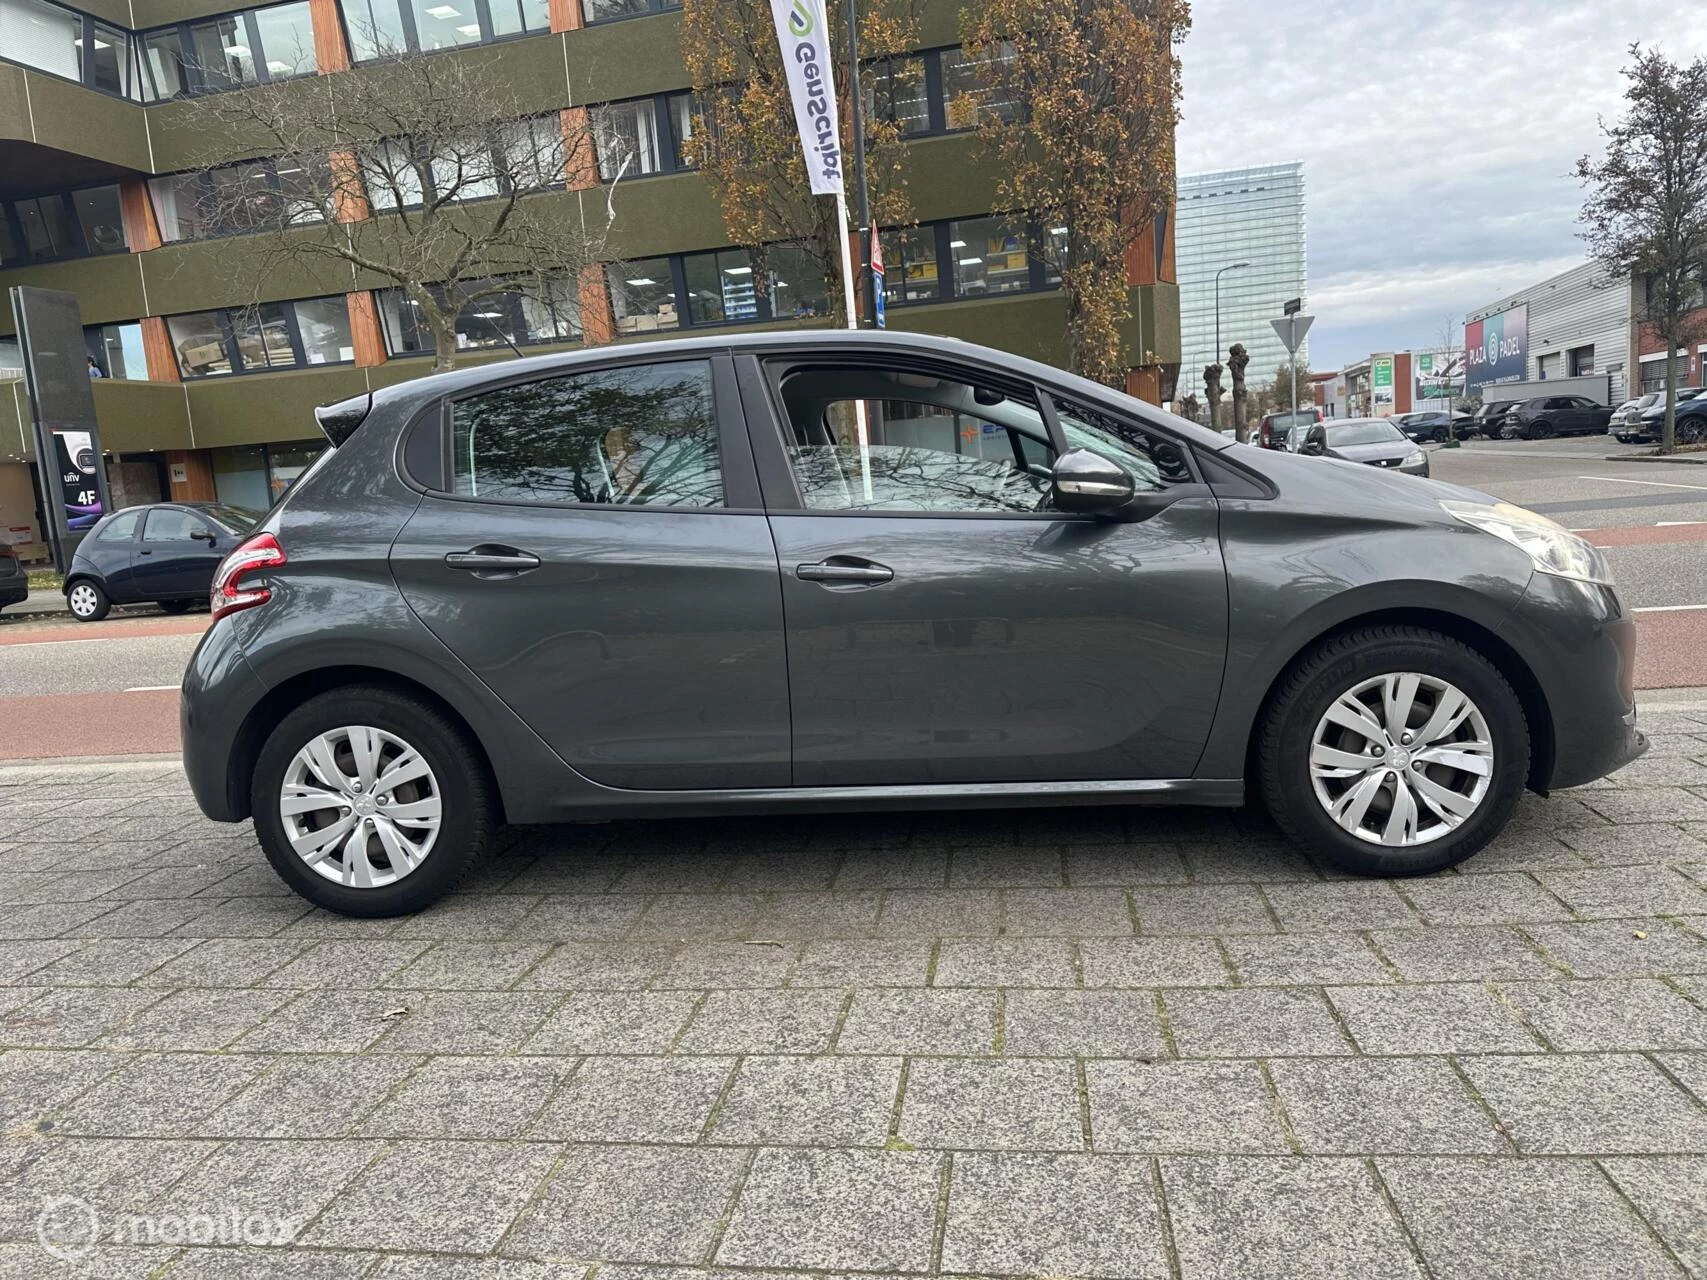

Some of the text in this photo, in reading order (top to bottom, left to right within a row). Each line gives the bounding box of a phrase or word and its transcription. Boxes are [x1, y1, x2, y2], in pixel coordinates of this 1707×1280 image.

[1469, 336, 1520, 366] PLAZA PADEL
[78, 490, 95, 505] 4F
